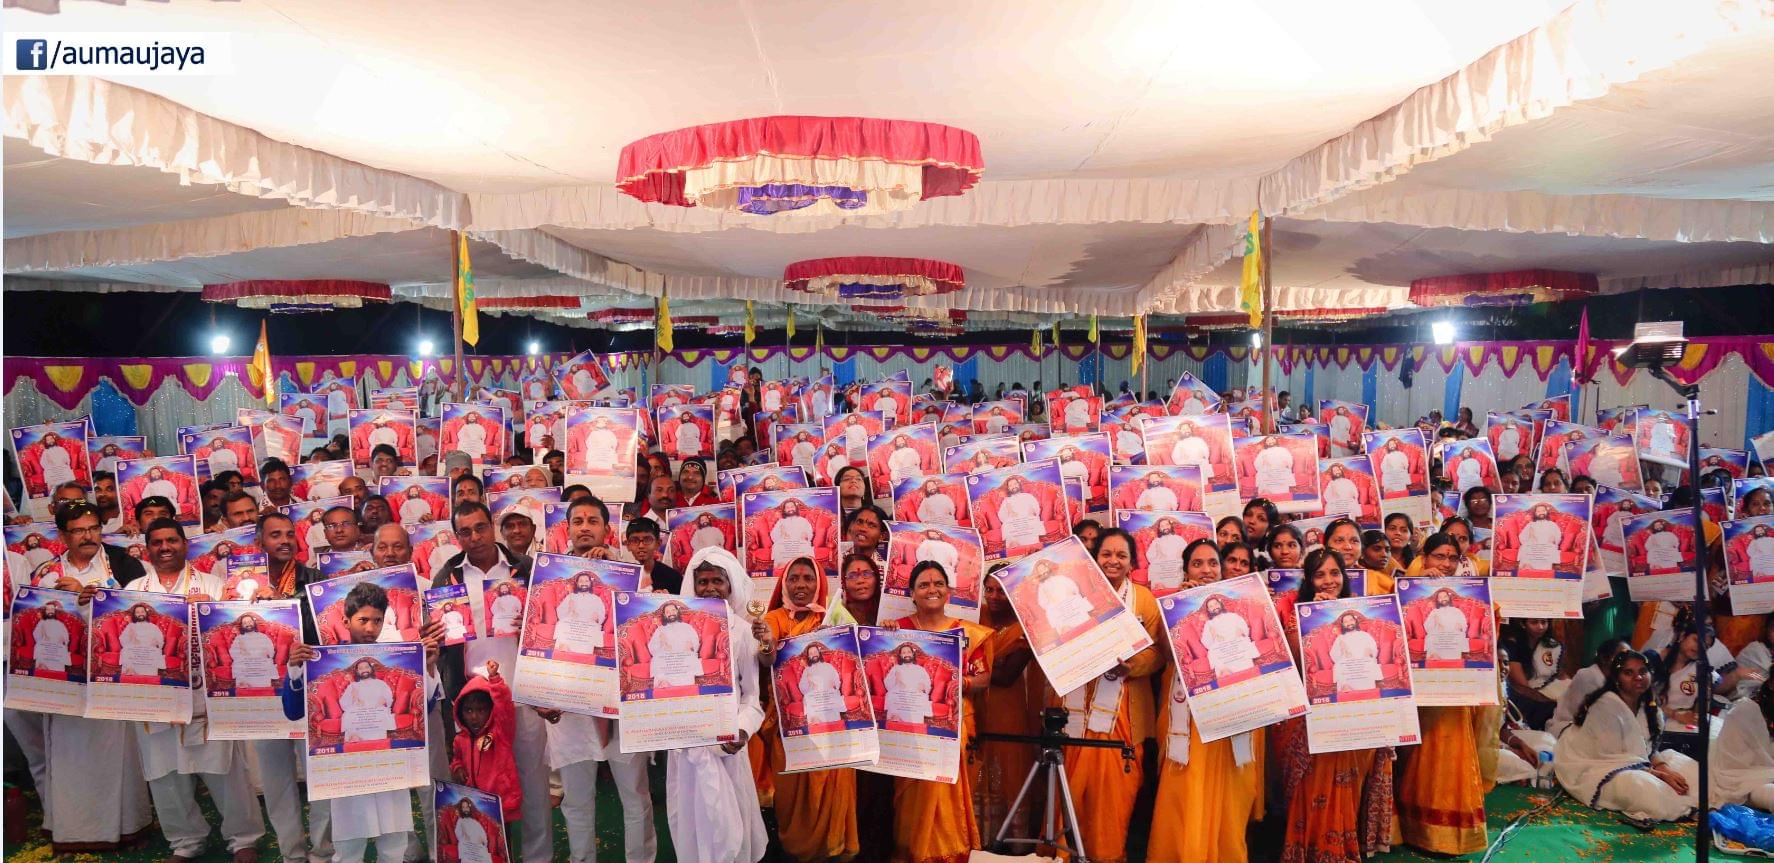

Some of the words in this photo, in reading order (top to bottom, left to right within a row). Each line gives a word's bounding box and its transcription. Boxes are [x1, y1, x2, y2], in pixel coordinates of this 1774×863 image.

[889, 588, 905, 596] 2018
[527, 649, 545, 657] 2018
[1194, 684, 1211, 694] 2018
